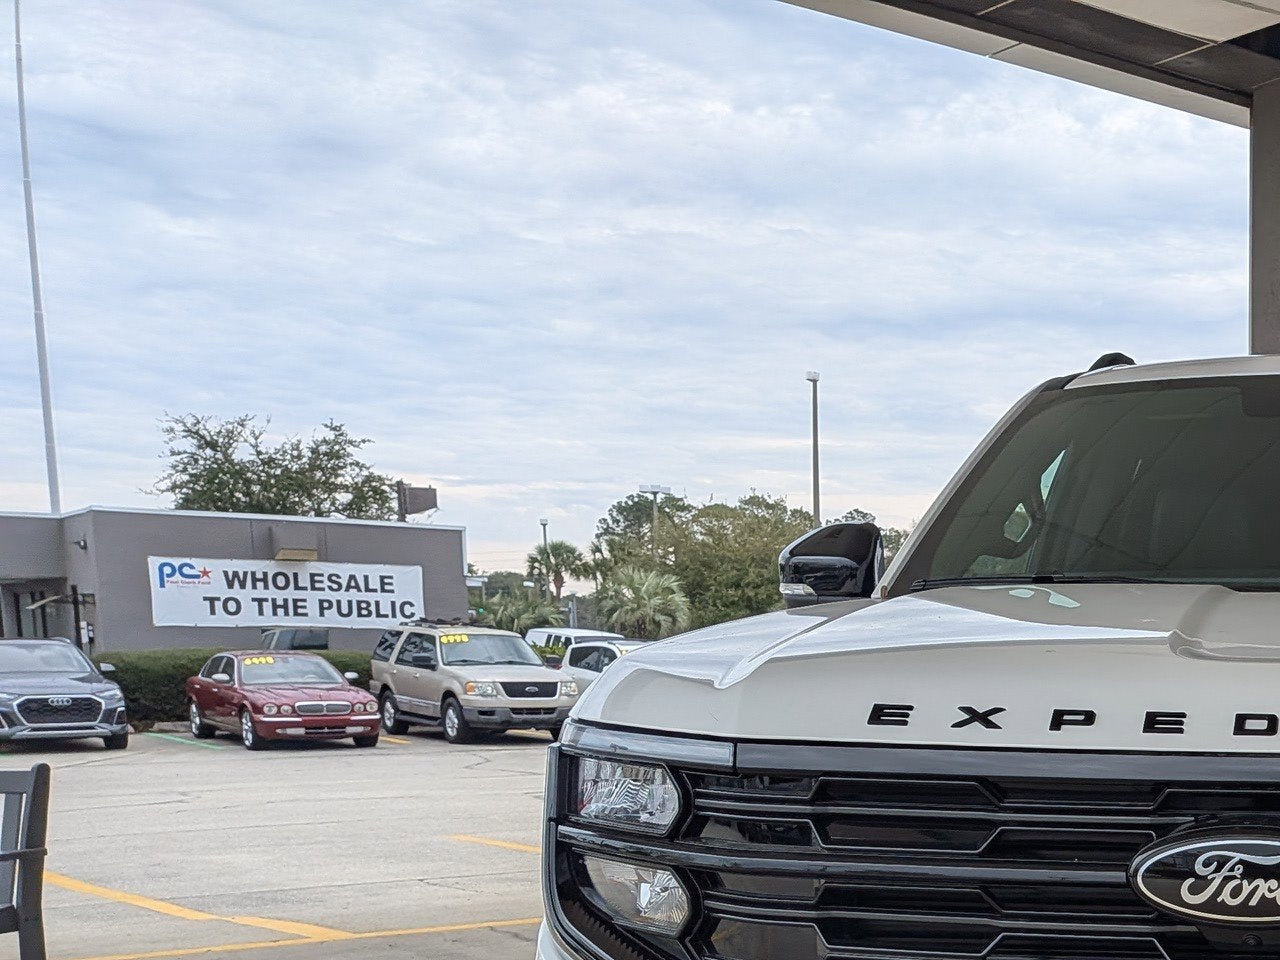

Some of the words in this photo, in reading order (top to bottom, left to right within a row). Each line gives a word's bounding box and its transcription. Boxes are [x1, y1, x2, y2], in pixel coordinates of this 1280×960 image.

[222, 570, 395, 594] WHOLESALE
[202, 596, 242, 617] TO
[251, 597, 309, 617] THE
[318, 599, 417, 620] PUBLIC
